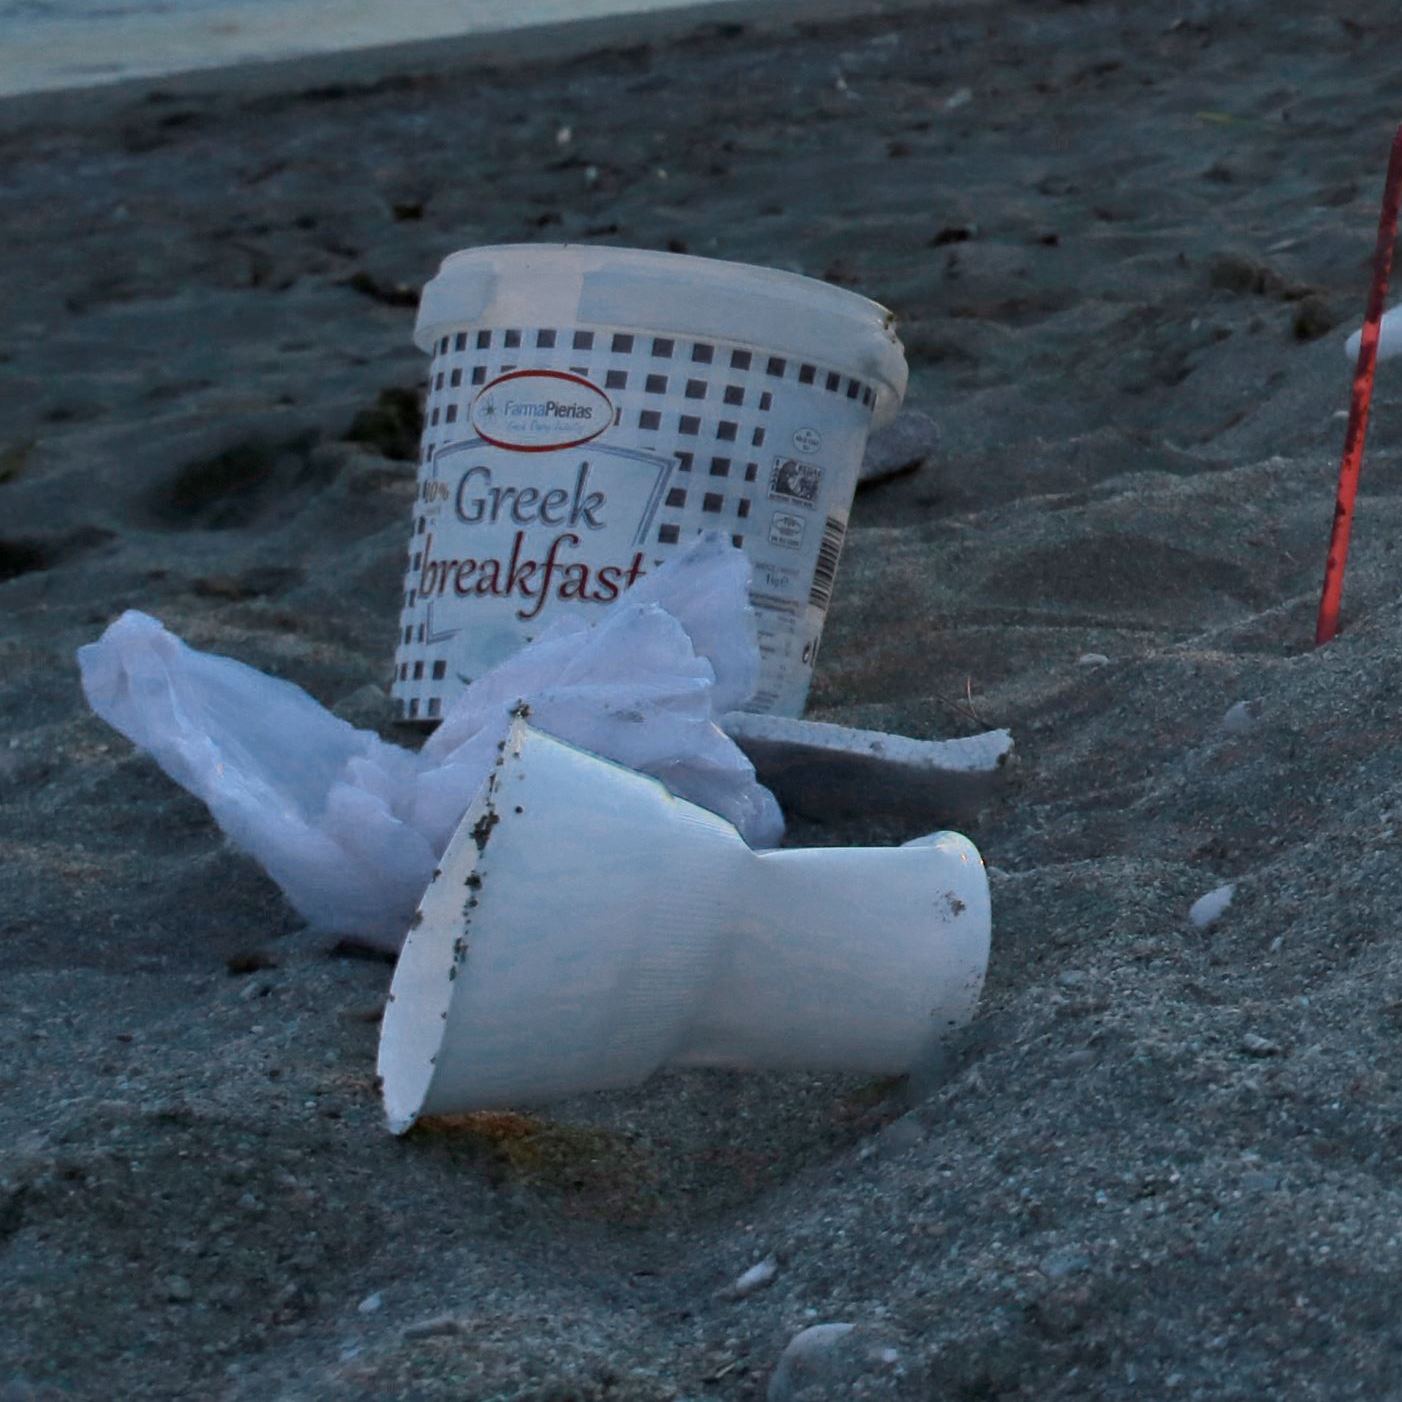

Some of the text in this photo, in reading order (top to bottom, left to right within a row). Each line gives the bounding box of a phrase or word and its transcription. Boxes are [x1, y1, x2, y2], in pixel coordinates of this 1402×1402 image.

[503, 400, 593, 420] FarmaPierias
[455, 461, 606, 528] Greek
[418, 531, 648, 620] breakfast
